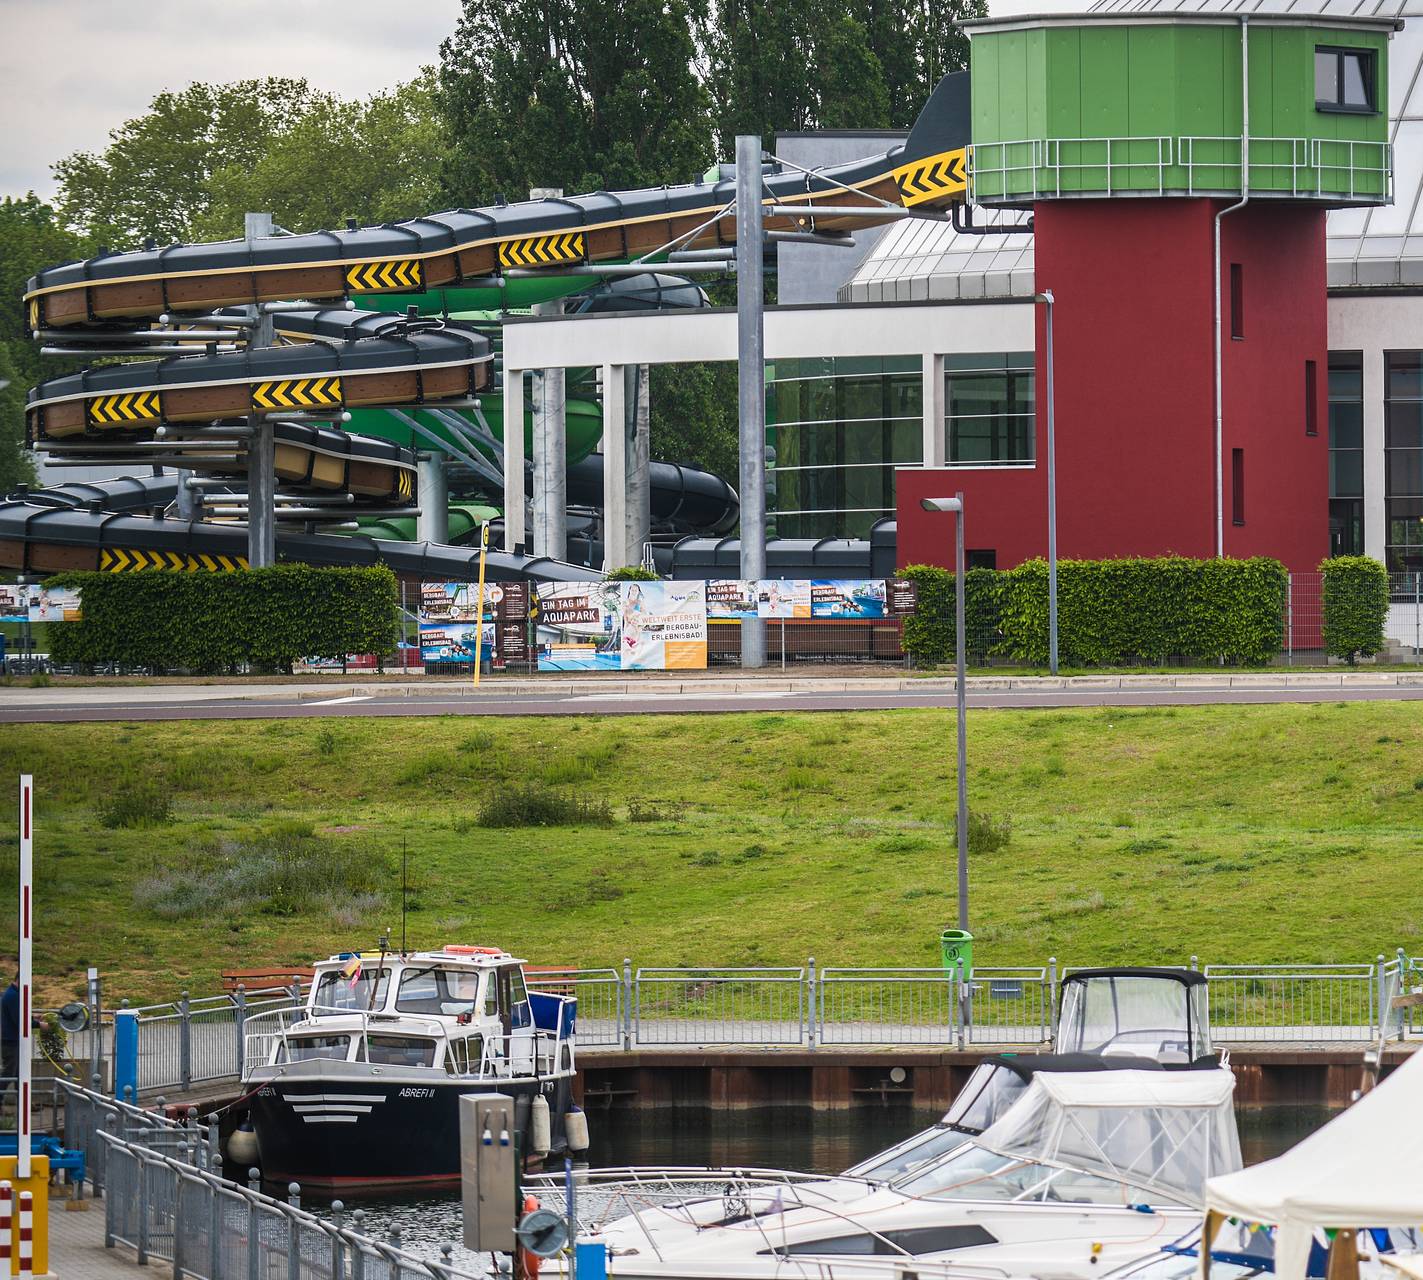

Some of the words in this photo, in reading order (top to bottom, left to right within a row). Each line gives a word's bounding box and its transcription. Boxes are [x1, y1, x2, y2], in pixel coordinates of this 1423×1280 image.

[708, 593, 742, 601] AQUAPARK
[542, 601, 555, 610] EIN
[558, 599, 574, 609] TAG
[576, 598, 586, 607] IM
[543, 610, 596, 623] AQUAPARK
[641, 615, 679, 624] WELTWEIT
[680, 613, 703, 621] ERSTE
[666, 623, 702, 631] BERGBAU-
[651, 632, 703, 640] ERLEBNISBAD!
[399, 1088, 429, 1097] ABREFI
